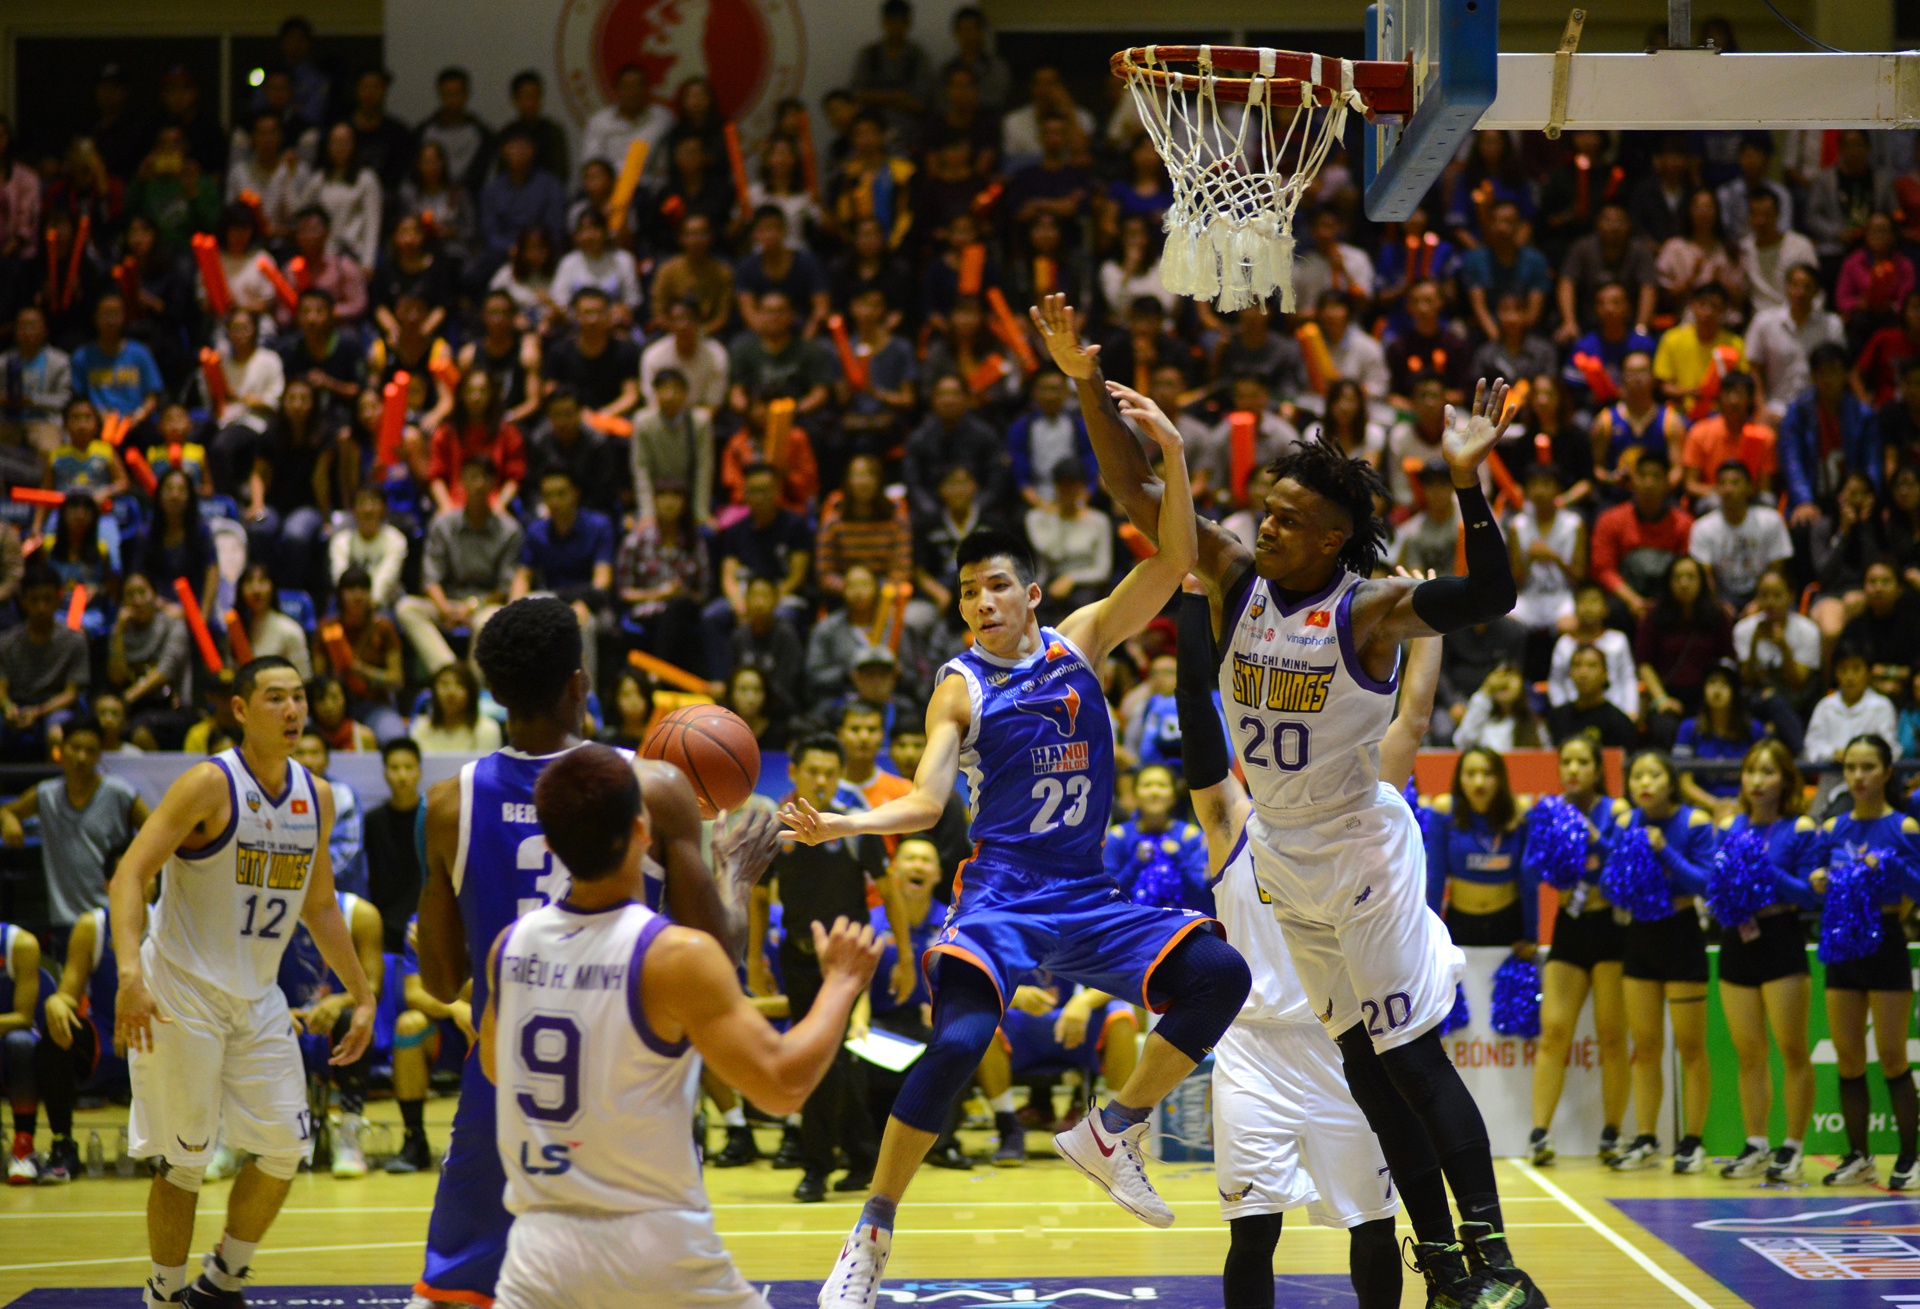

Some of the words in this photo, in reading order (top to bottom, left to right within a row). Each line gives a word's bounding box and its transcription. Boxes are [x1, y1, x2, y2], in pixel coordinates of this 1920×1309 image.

[1286, 633, 1337, 647] vinaphone
[1036, 661, 1085, 685] vinaphon
[1261, 655, 1279, 667] CHI
[1281, 658, 1309, 672] MINH
[1233, 656, 1265, 710] CITY
[1266, 667, 1334, 713] WINGS
[1032, 742, 1088, 765] HANOI
[1239, 713, 1312, 774] 20
[1034, 759, 1089, 774] BUFFALOES
[1029, 775, 1092, 834] 23
[236, 847, 268, 888] CITY
[240, 894, 288, 939] 12
[573, 963, 626, 991] MINH
[1361, 991, 1412, 1037] 20
[1454, 1036, 1516, 1068] BÓNG
[1523, 1039, 1538, 1068] R
[514, 1009, 586, 1128] 9
[1812, 1112, 1887, 1134] YOH
